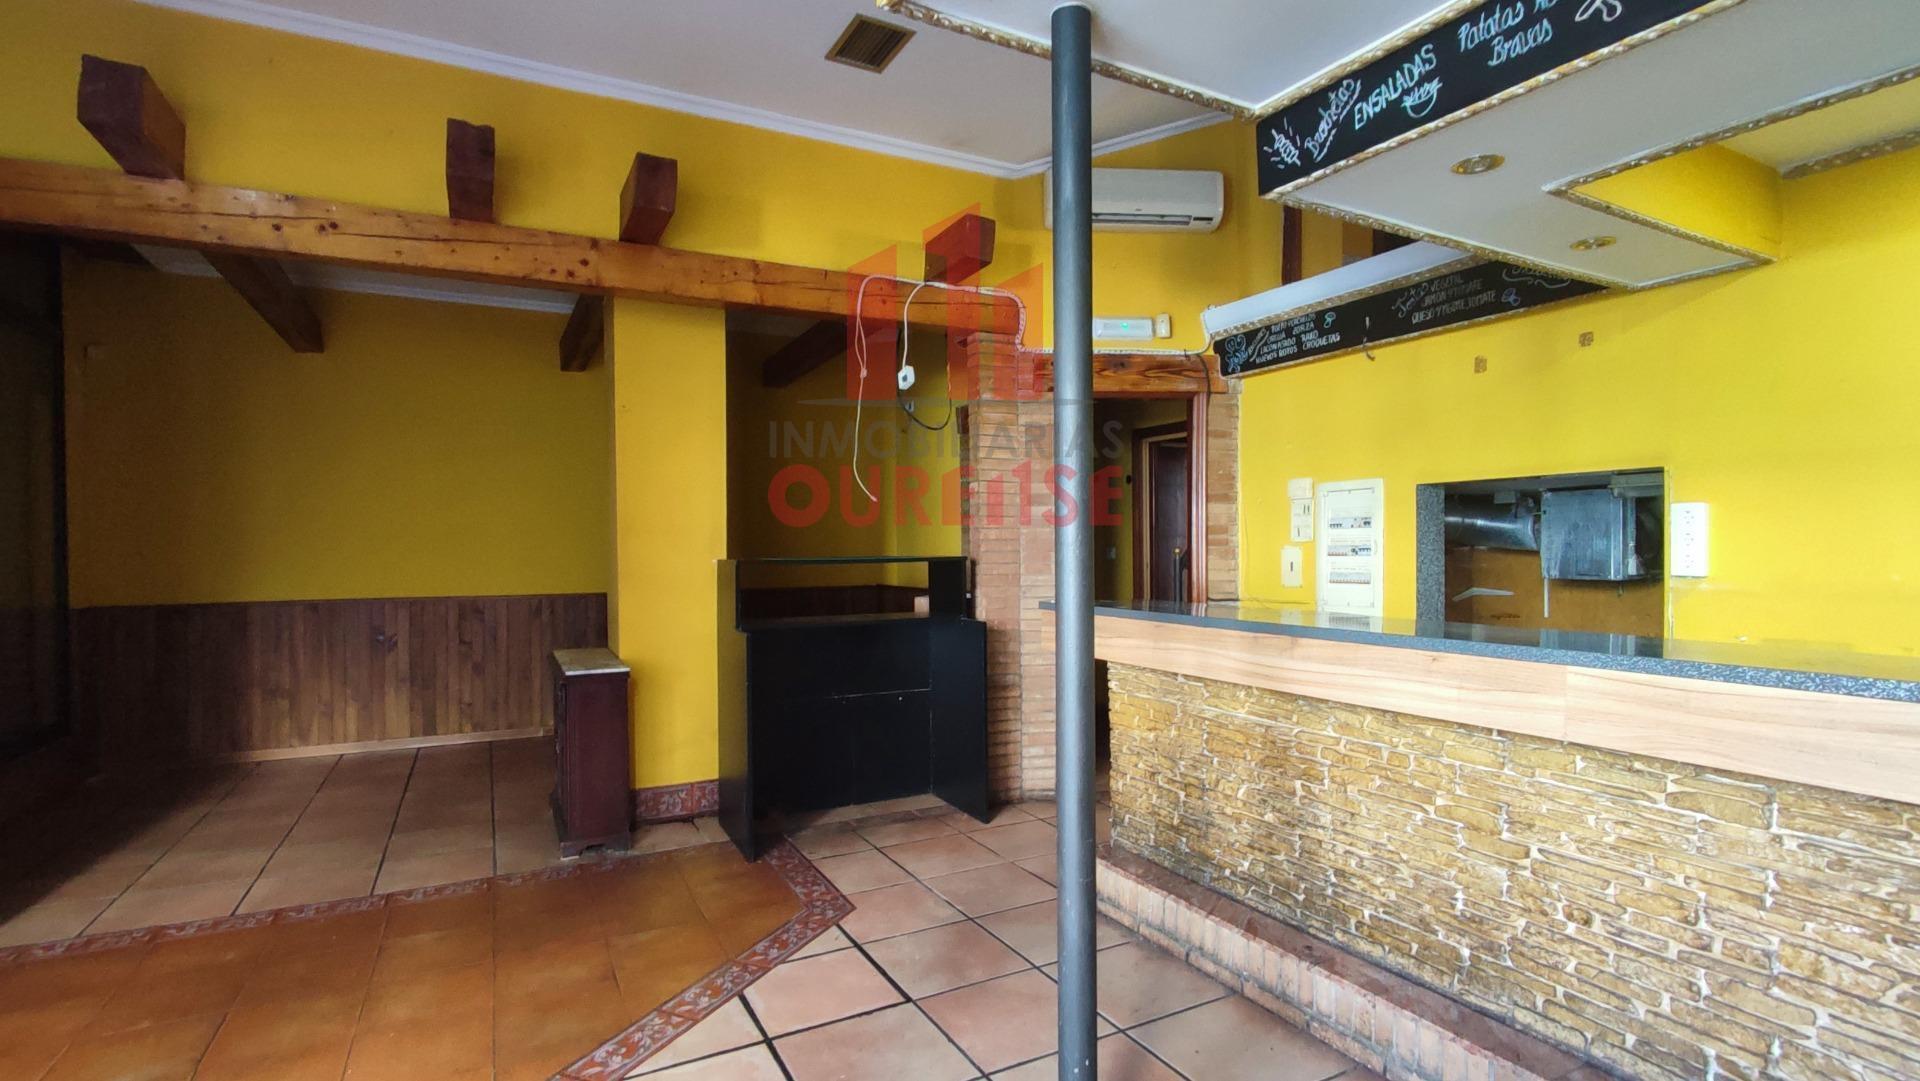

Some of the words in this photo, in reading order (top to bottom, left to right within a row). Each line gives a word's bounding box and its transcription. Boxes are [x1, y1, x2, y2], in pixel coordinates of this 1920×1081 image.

[1457, 1, 1525, 53] Patatas
[1487, 18, 1553, 67] Bravas
[1353, 44, 1438, 131] ENSALADAS
[1412, 305, 1435, 324] QUESO
[1278, 345, 1298, 358] ROTOS
[1302, 332, 1341, 350] CROQUETAS
